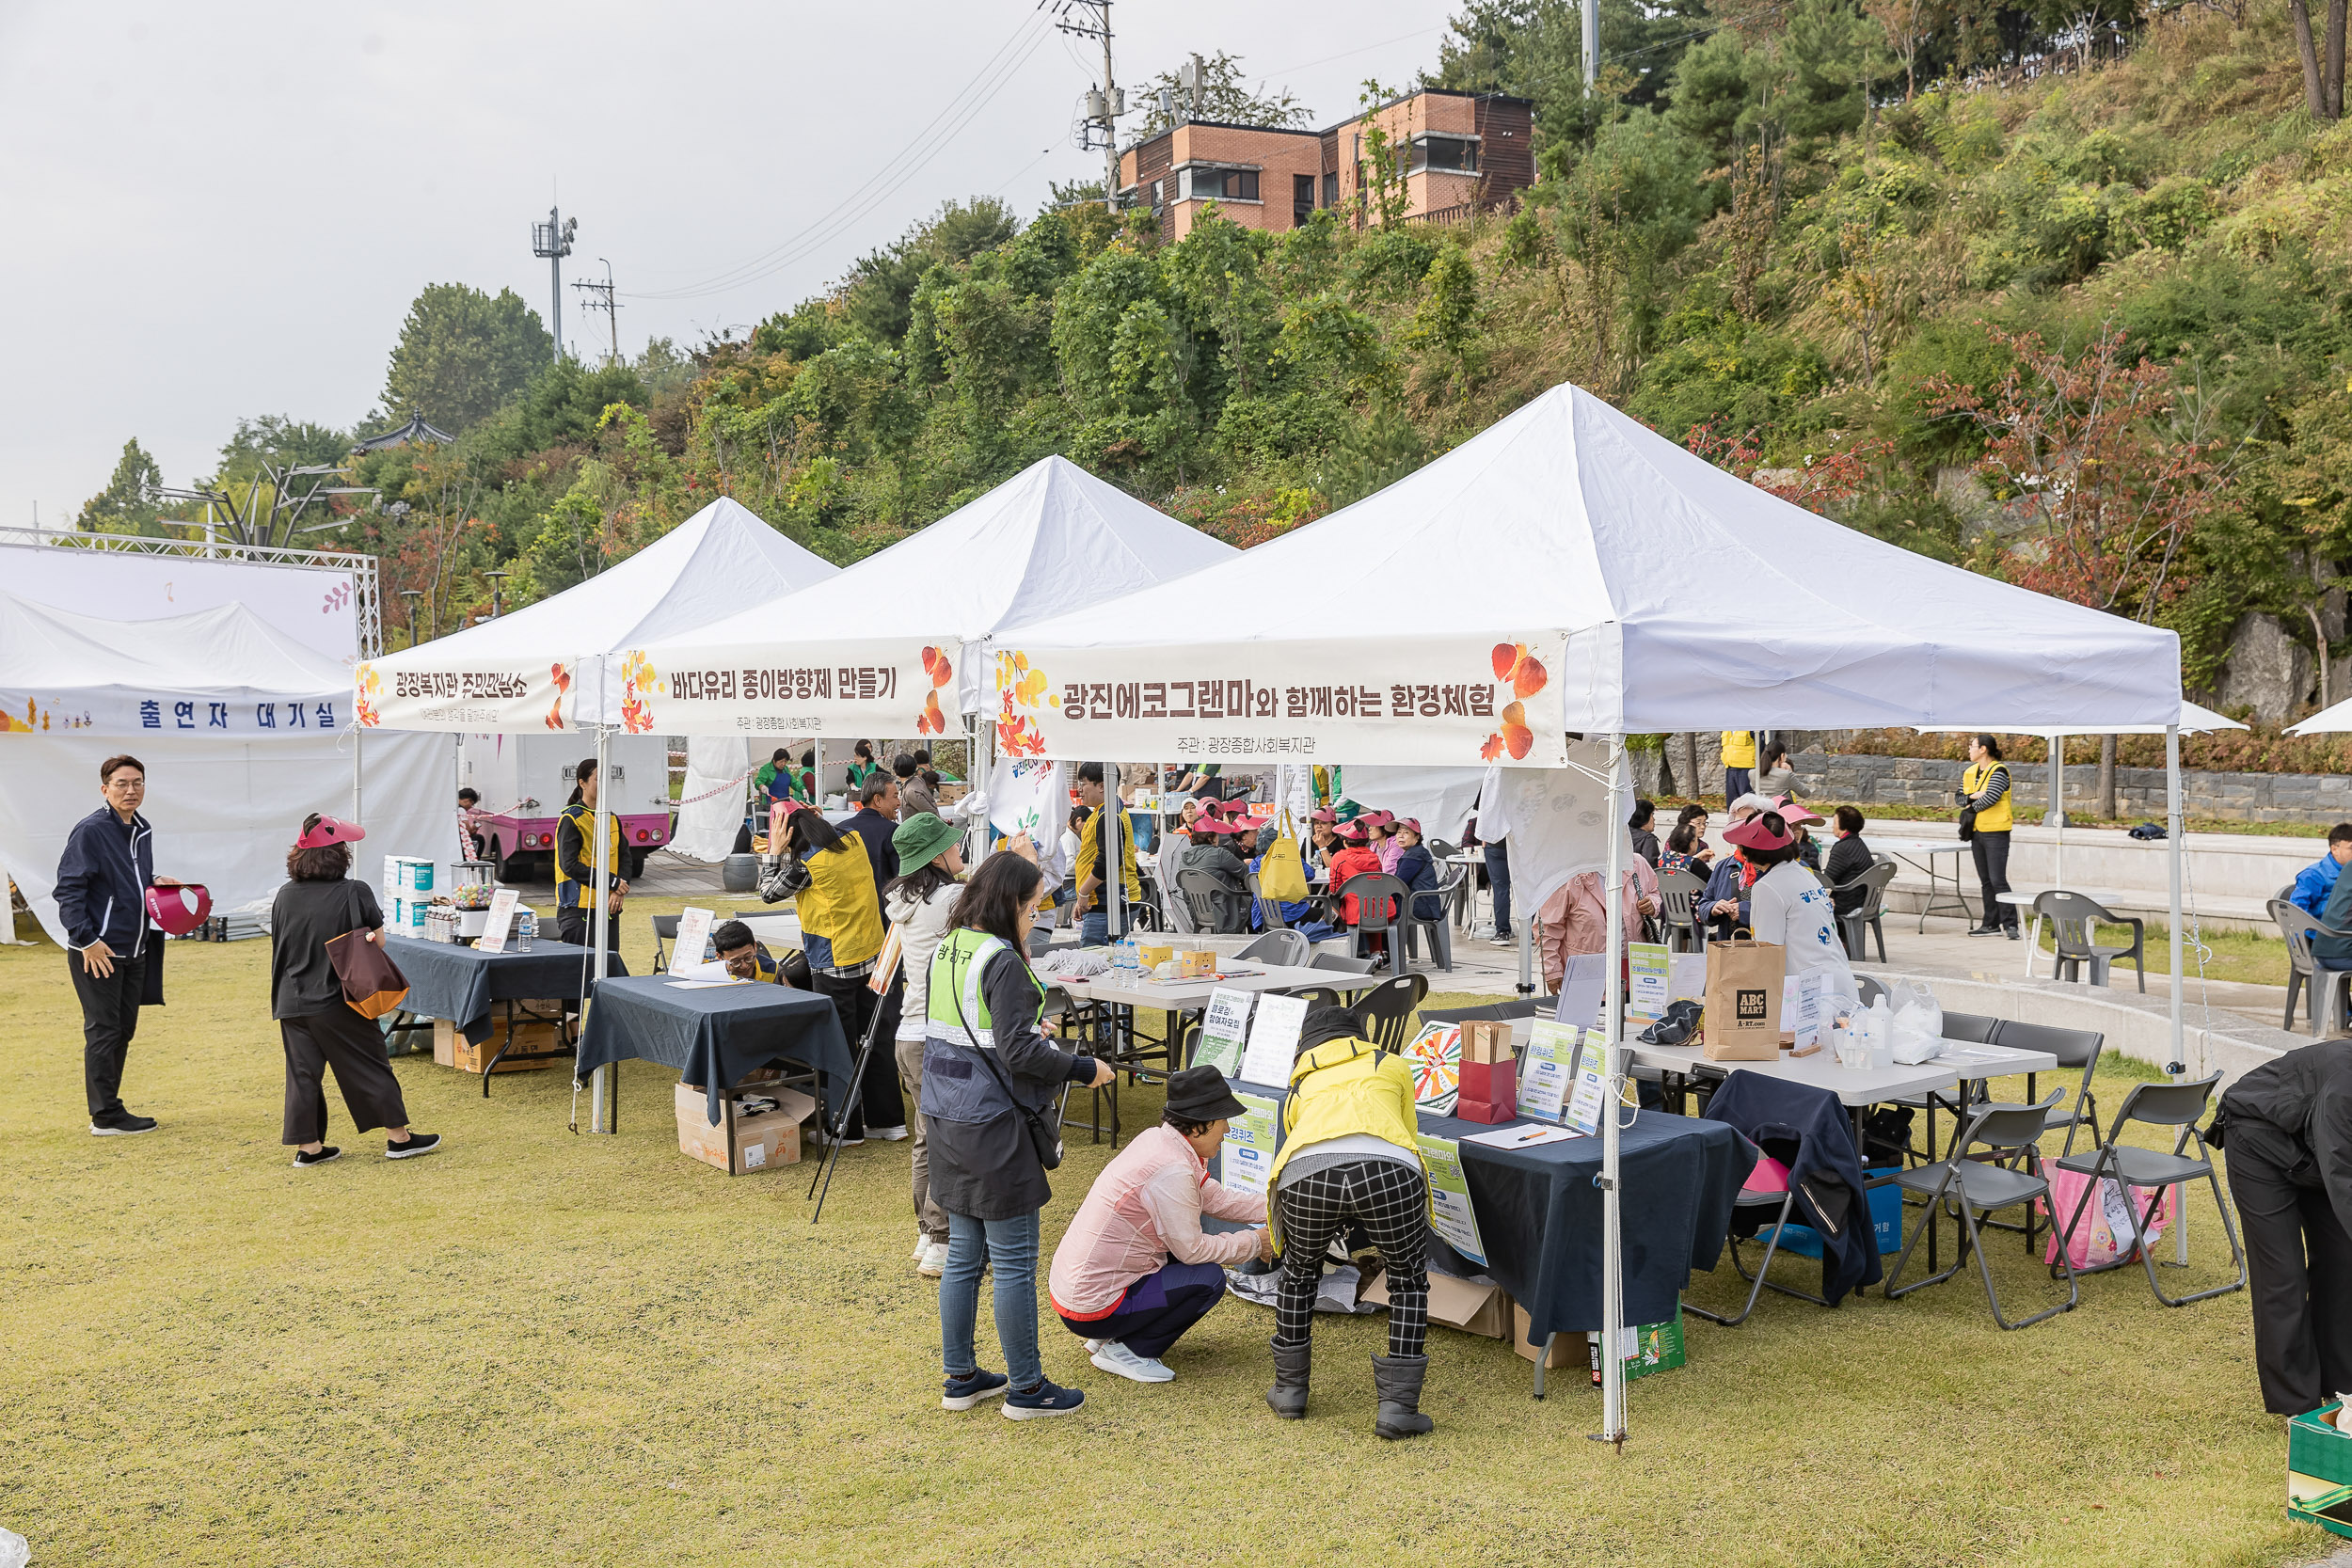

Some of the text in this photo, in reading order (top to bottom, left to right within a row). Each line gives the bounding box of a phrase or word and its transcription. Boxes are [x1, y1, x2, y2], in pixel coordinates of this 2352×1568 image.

[396, 673, 528, 699] 광장복지관 주민만남소
[671, 666, 897, 701] 바다유리 종이방향제 만들기
[1063, 678, 1494, 720] 광진에코그랜마와 함께하는 환경체험
[139, 699, 335, 729] 출연자 대기실
[737, 717, 751, 730] 주관
[755, 717, 822, 731] 광장종합사회복지관
[1178, 736, 1200, 754] 주관
[1208, 736, 1316, 754] 광장종합사회복지관
[1740, 993, 1764, 1006] ABC
[1740, 1006, 1764, 1015] MART
[1209, 1014, 1240, 1030] 참여자모집
